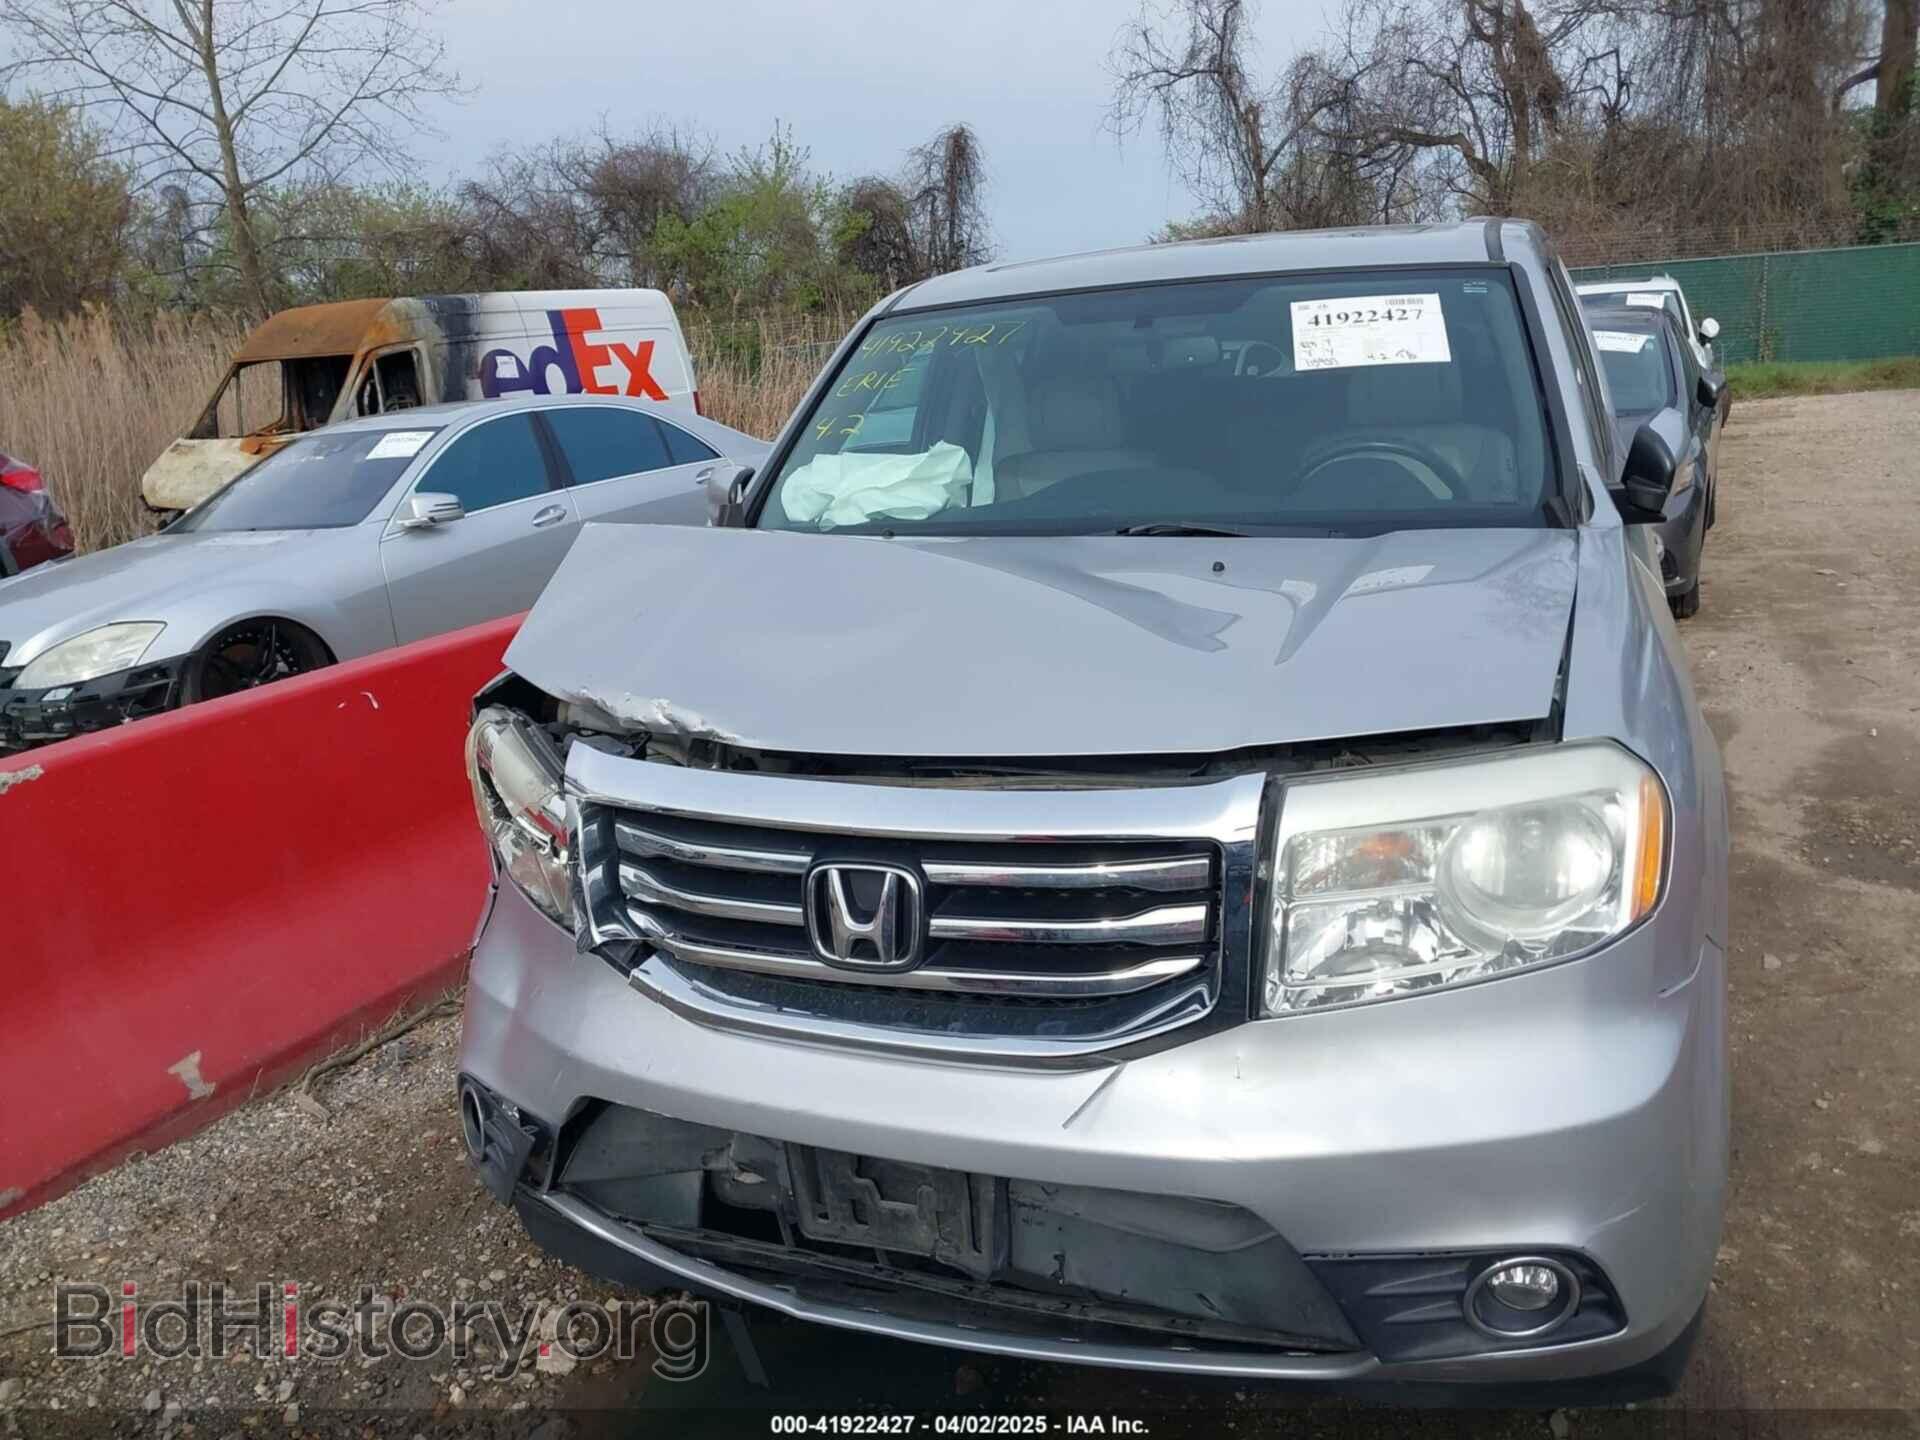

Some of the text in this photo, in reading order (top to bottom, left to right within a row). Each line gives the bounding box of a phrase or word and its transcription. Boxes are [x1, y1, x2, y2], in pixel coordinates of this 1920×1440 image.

[1307, 308, 1424, 327] 41922427
[479, 308, 670, 401] edEx
[836, 368, 917, 398] ERIE
